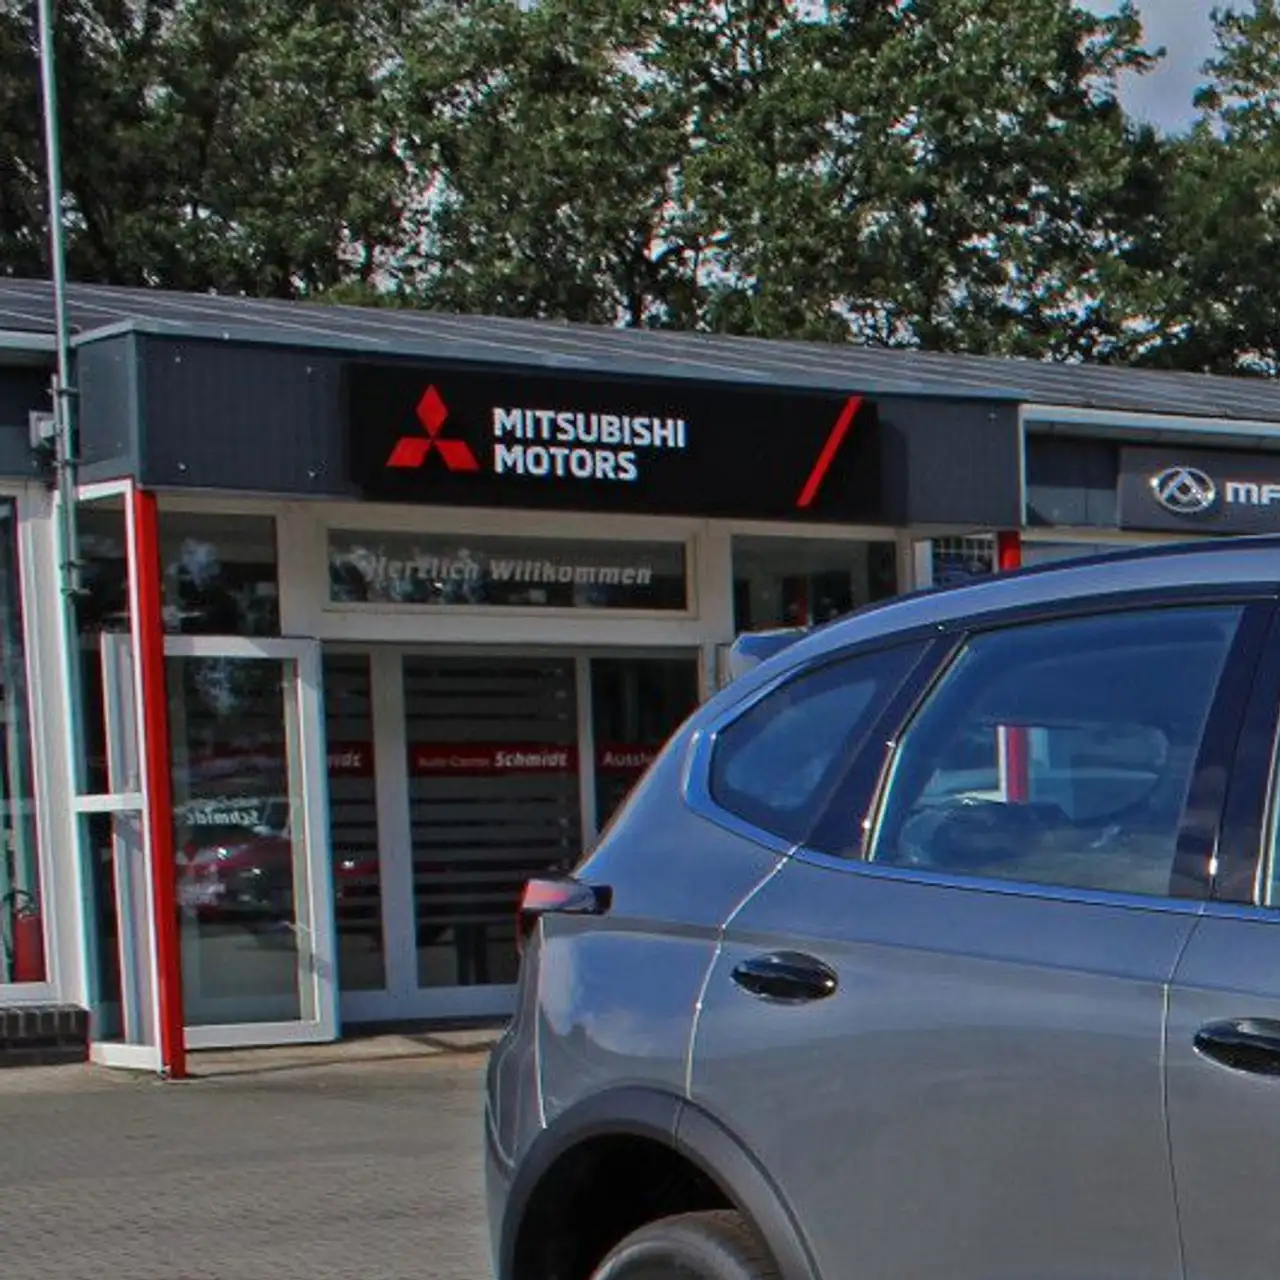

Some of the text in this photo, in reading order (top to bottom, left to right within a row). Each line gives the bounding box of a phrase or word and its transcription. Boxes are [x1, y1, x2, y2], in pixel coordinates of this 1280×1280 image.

[493, 407, 686, 448] MITSUBISHI
[494, 443, 638, 481] MOTORS
[372, 556, 652, 585] Herzlich Willkommen
[494, 751, 568, 767] Schmidt
